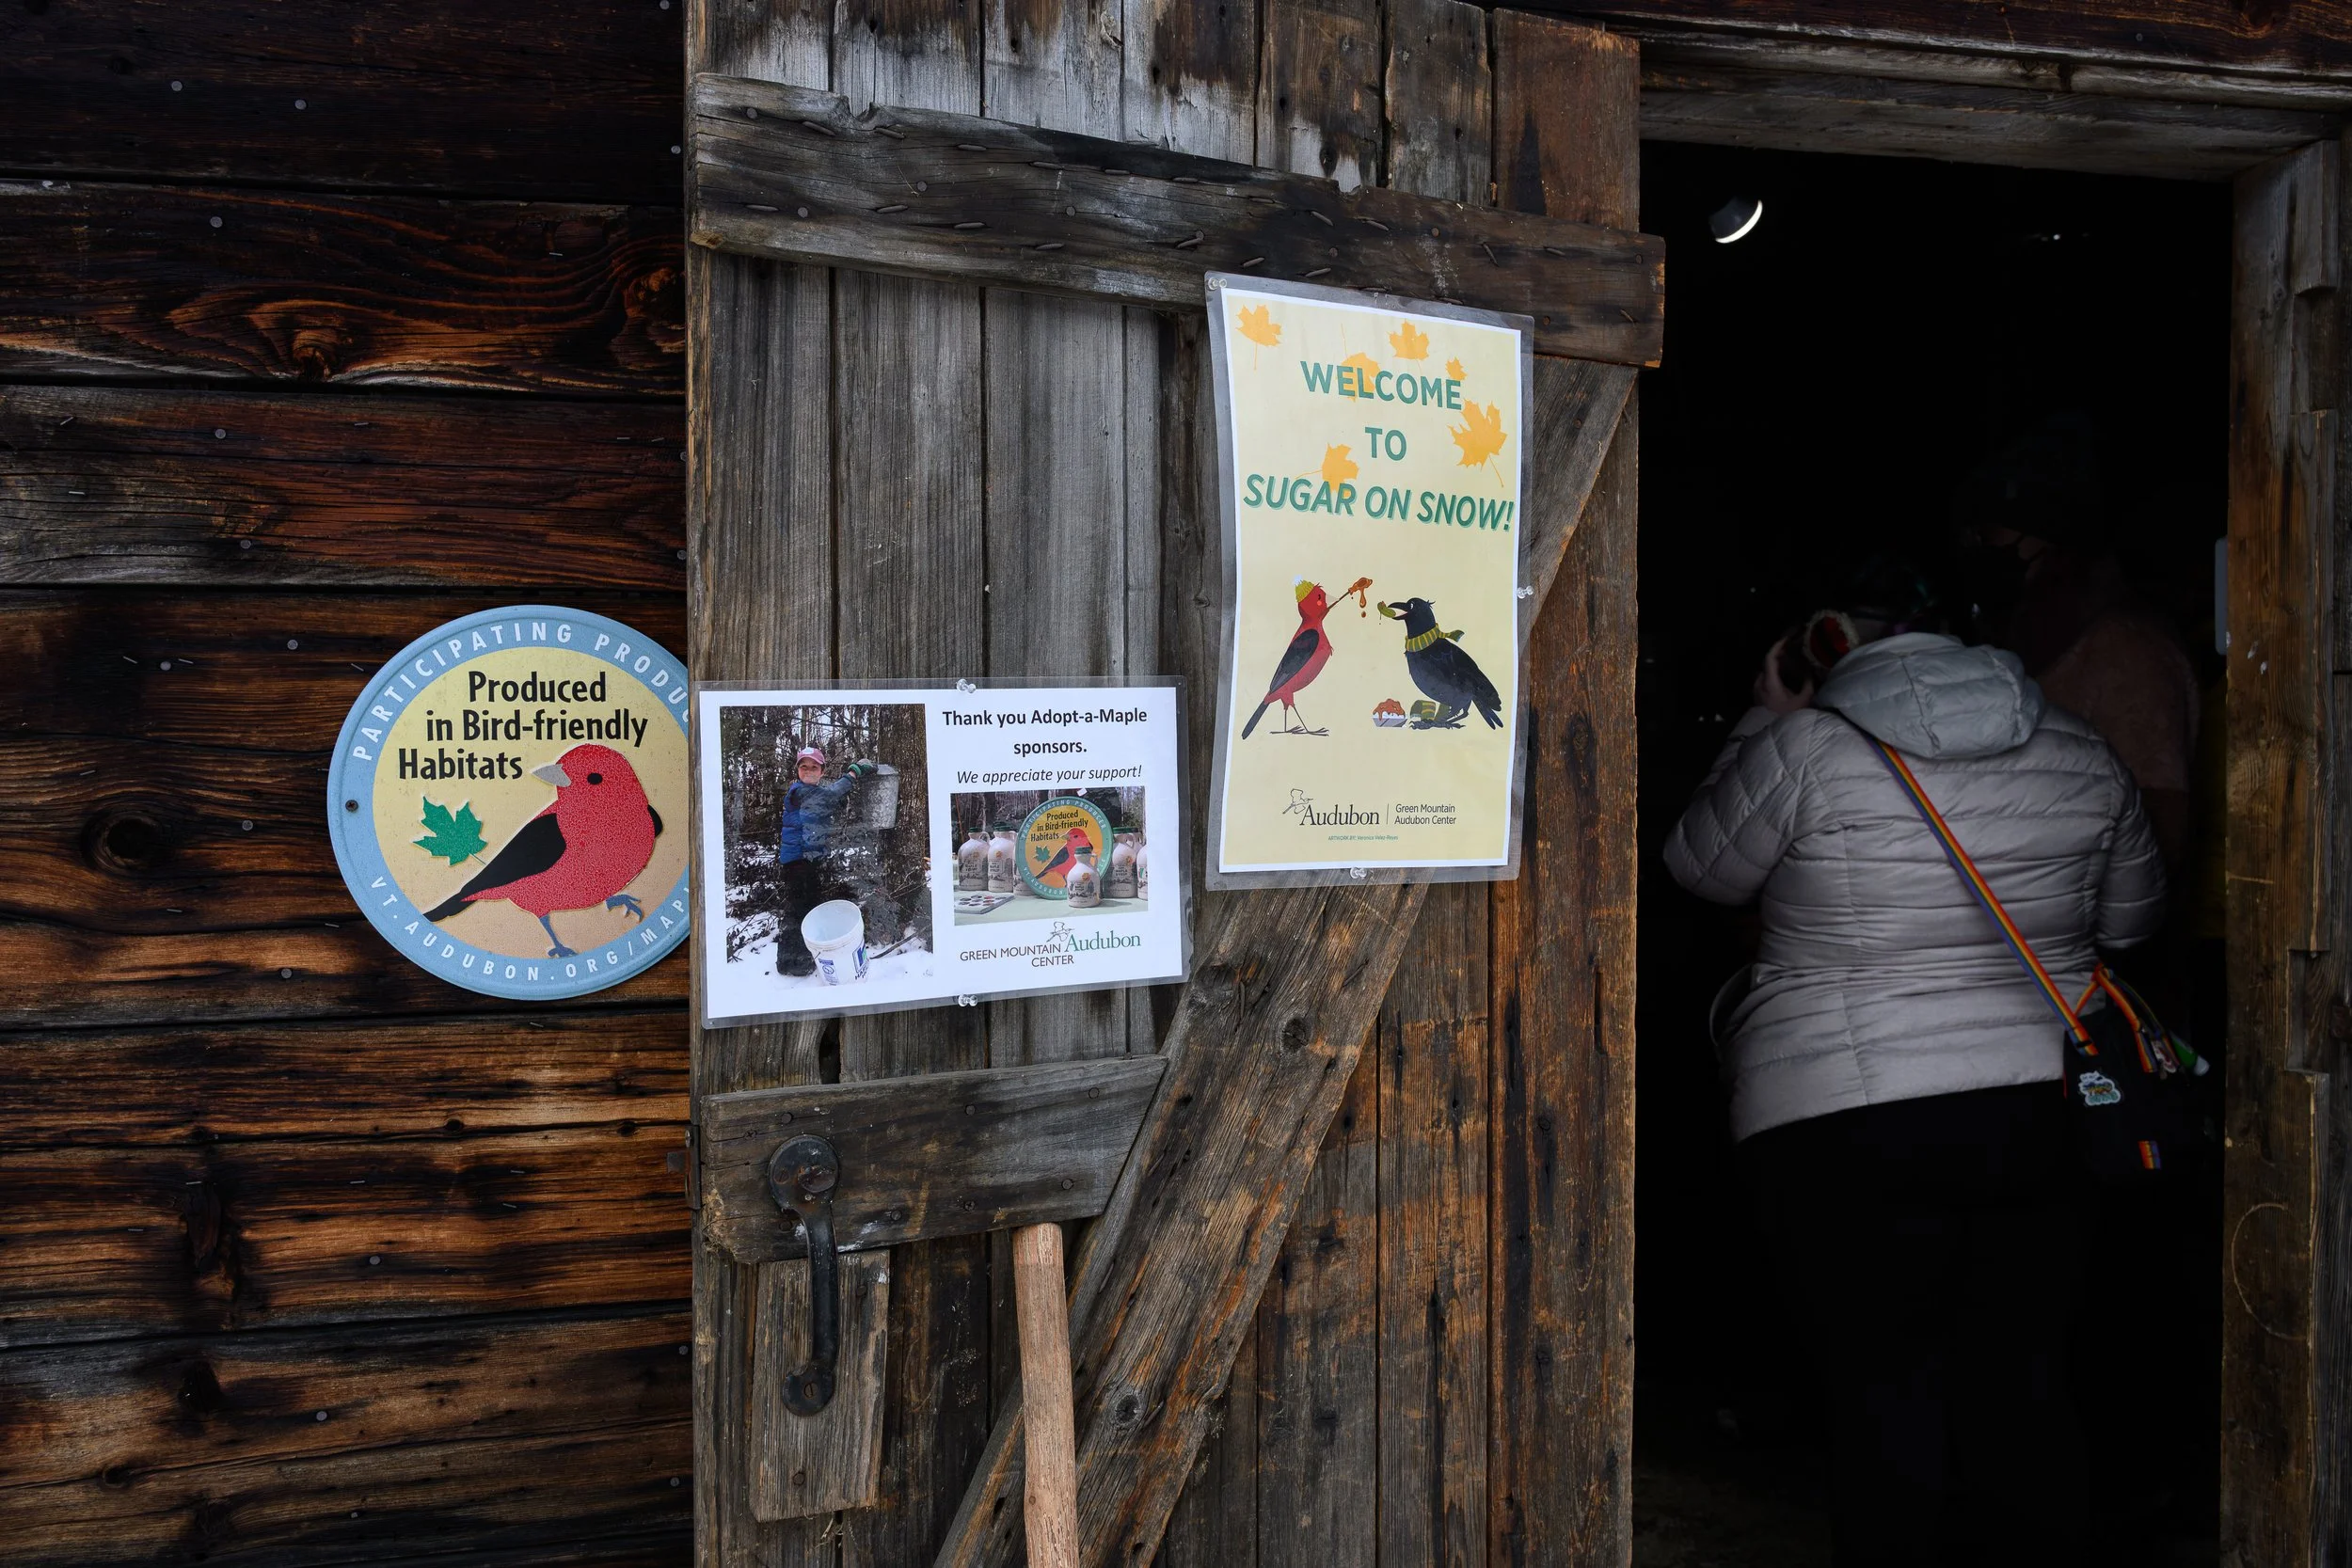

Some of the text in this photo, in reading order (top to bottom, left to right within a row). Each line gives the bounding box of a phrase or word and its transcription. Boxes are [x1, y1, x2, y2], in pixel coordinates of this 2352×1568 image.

[1300, 360, 1462, 410] WELCOME
[1364, 426, 1407, 462] TO
[1243, 473, 1515, 531] SUGAR ON SNOW!
[353, 622, 572, 761] PARTICIPATING
[469, 671, 607, 704] Produced
[426, 707, 648, 748] in Bird-friendly
[943, 707, 1148, 728] Thank you Adopt-a-Maple
[1013, 741, 1087, 757] sponsors.
[399, 748, 523, 781] Habitats
[957, 764, 1142, 785] We appreciate your support!
[1046, 810, 1079, 821] Produced
[1299, 804, 1379, 826] Audubon
[1395, 803, 1455, 814] Green Mountain
[1045, 818, 1089, 831] Bird-friendly
[1394, 816, 1456, 825] Audubon Center
[1031, 832, 1059, 842] Habitats
[371, 876, 689, 980] VT.AUDUBON.ORG/MAP
[960, 930, 1141, 961] GREEN MOUNTAIN Audubon
[1031, 955, 1074, 967] CENTER
